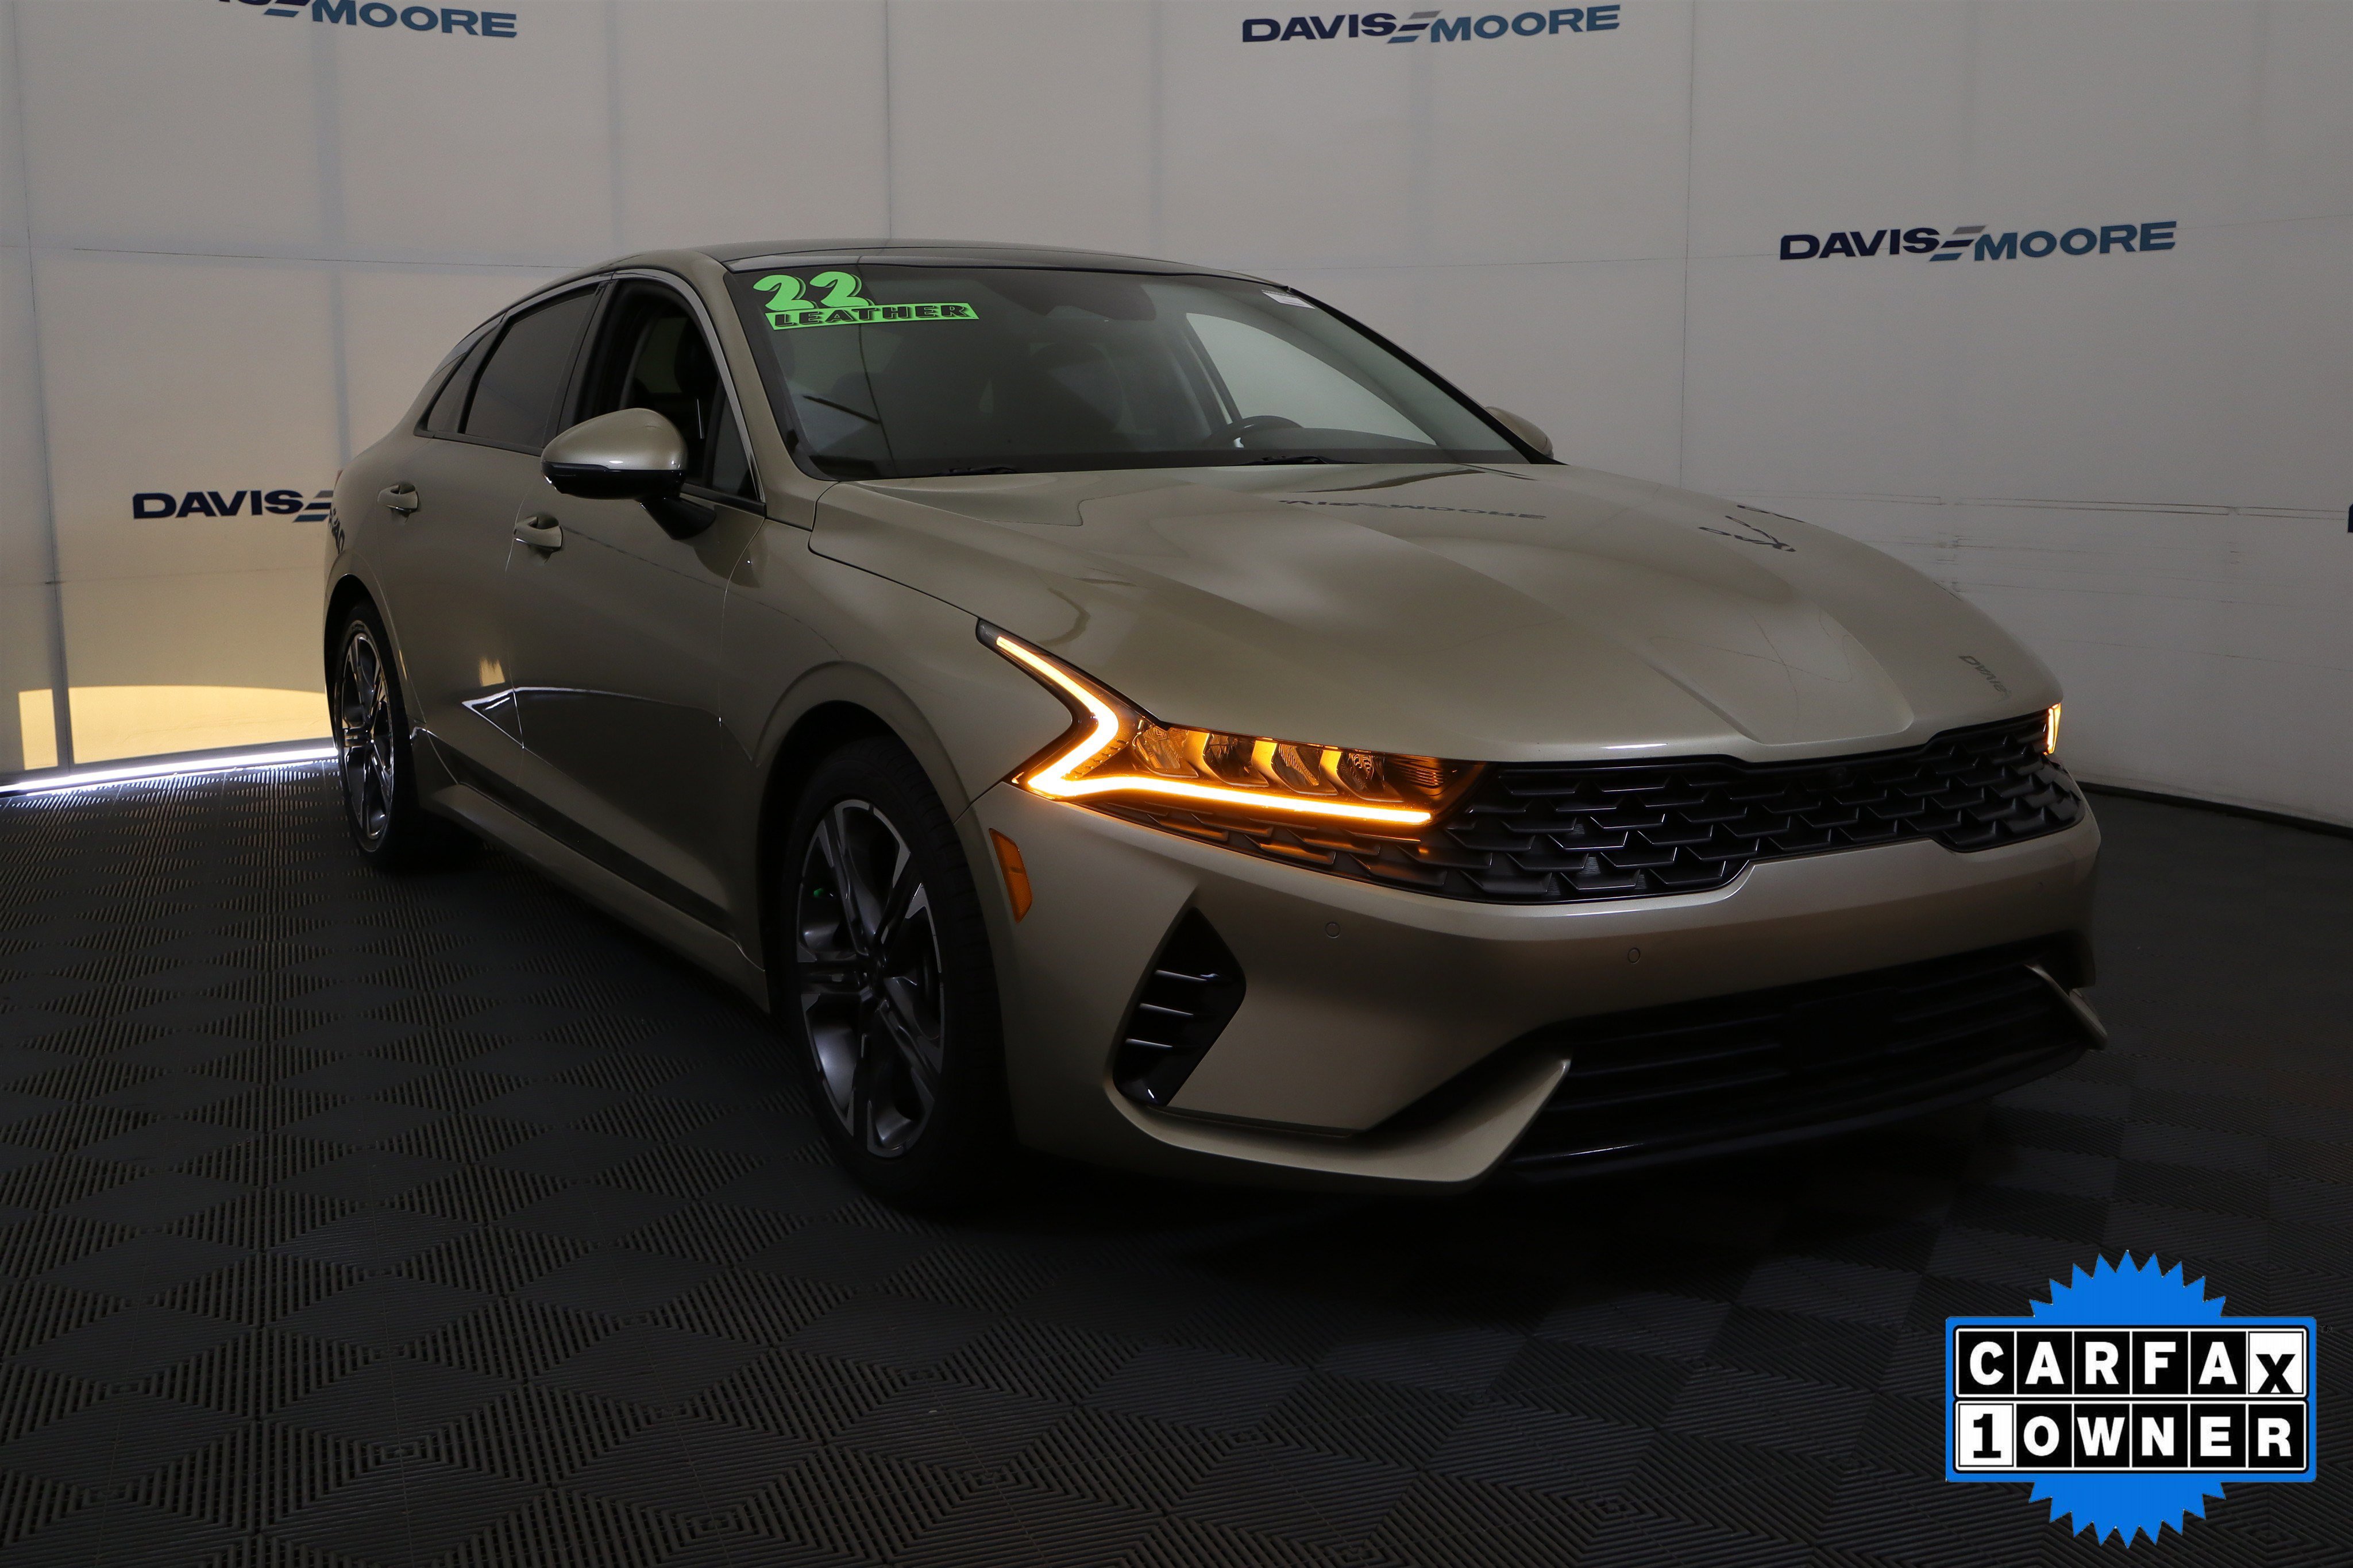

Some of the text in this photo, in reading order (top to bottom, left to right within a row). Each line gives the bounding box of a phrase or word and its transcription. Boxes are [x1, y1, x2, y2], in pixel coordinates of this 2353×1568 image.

[312, 0, 517, 38] MOORE
[1242, 5, 1621, 43] DAVIS MOORE
[1780, 221, 2177, 261] DAVIS MOORE
[753, 271, 874, 311] 22
[774, 305, 970, 327] LEATHER
[132, 489, 304, 519] DAVIS
